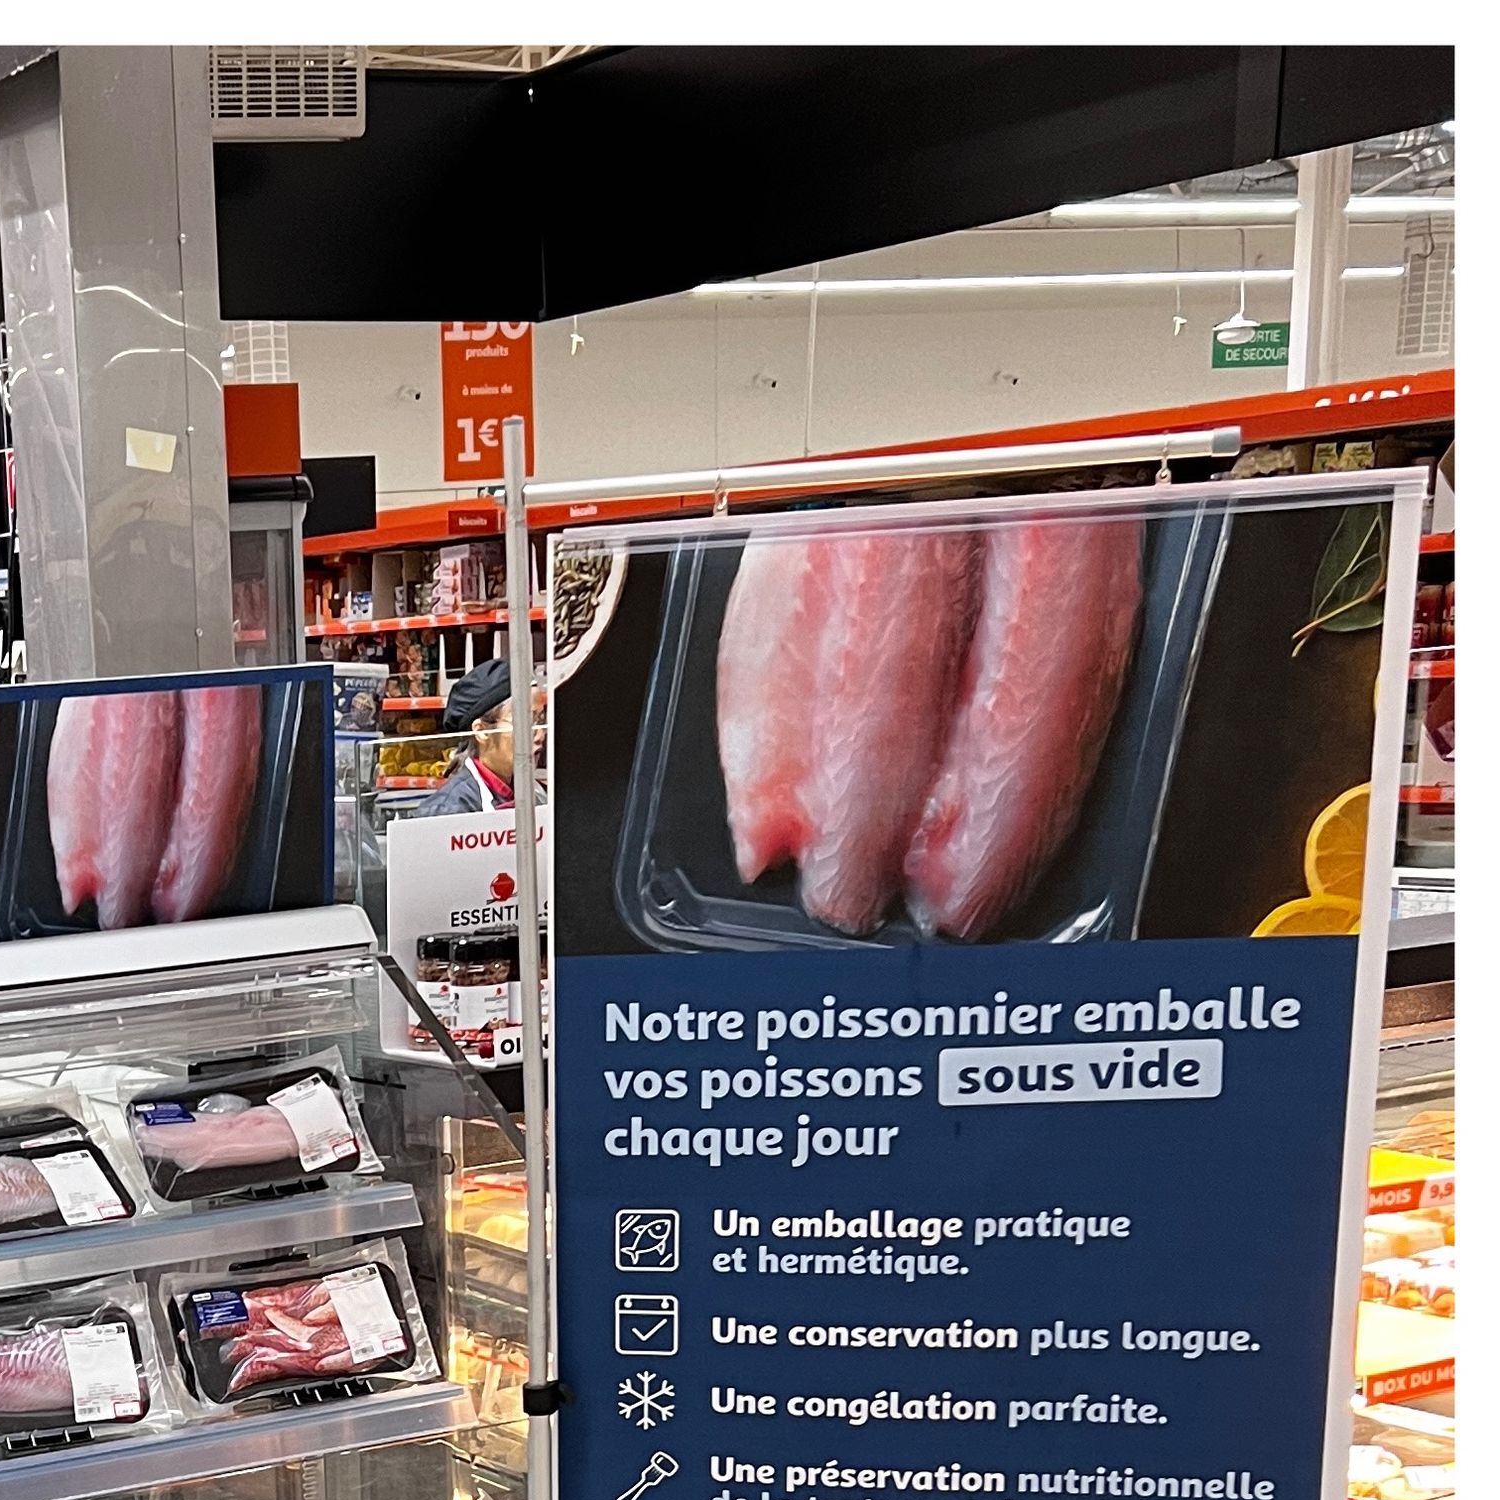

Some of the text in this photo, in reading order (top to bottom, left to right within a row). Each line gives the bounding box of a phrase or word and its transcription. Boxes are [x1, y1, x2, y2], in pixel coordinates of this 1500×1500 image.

[466, 344, 508, 360] produits
[1225, 347, 1288, 361] DE SECOUR
[1251, 329, 1281, 343] RTIE
[470, 384, 499, 396] moins
[501, 384, 513, 395] de
[451, 826, 544, 851] NOUVEU
[606, 986, 1300, 1050] Notre poissonnier emballe
[604, 1048, 1200, 1109] vos poissons sous vide
[605, 1115, 898, 1167] chaque jour
[1369, 1182, 1454, 1209] MOIS 9,9
[714, 1208, 1130, 1245] Un emballage pratique
[713, 1246, 968, 1282] et hermétique.
[713, 1317, 1260, 1358] Une conservation plus longue.
[1373, 1375, 1408, 1397] BOX
[1410, 1369, 1434, 1388] DU
[712, 1388, 1167, 1427] Une congélation parfaite.
[711, 1456, 1274, 1500] Une préservation nutritionnelle
